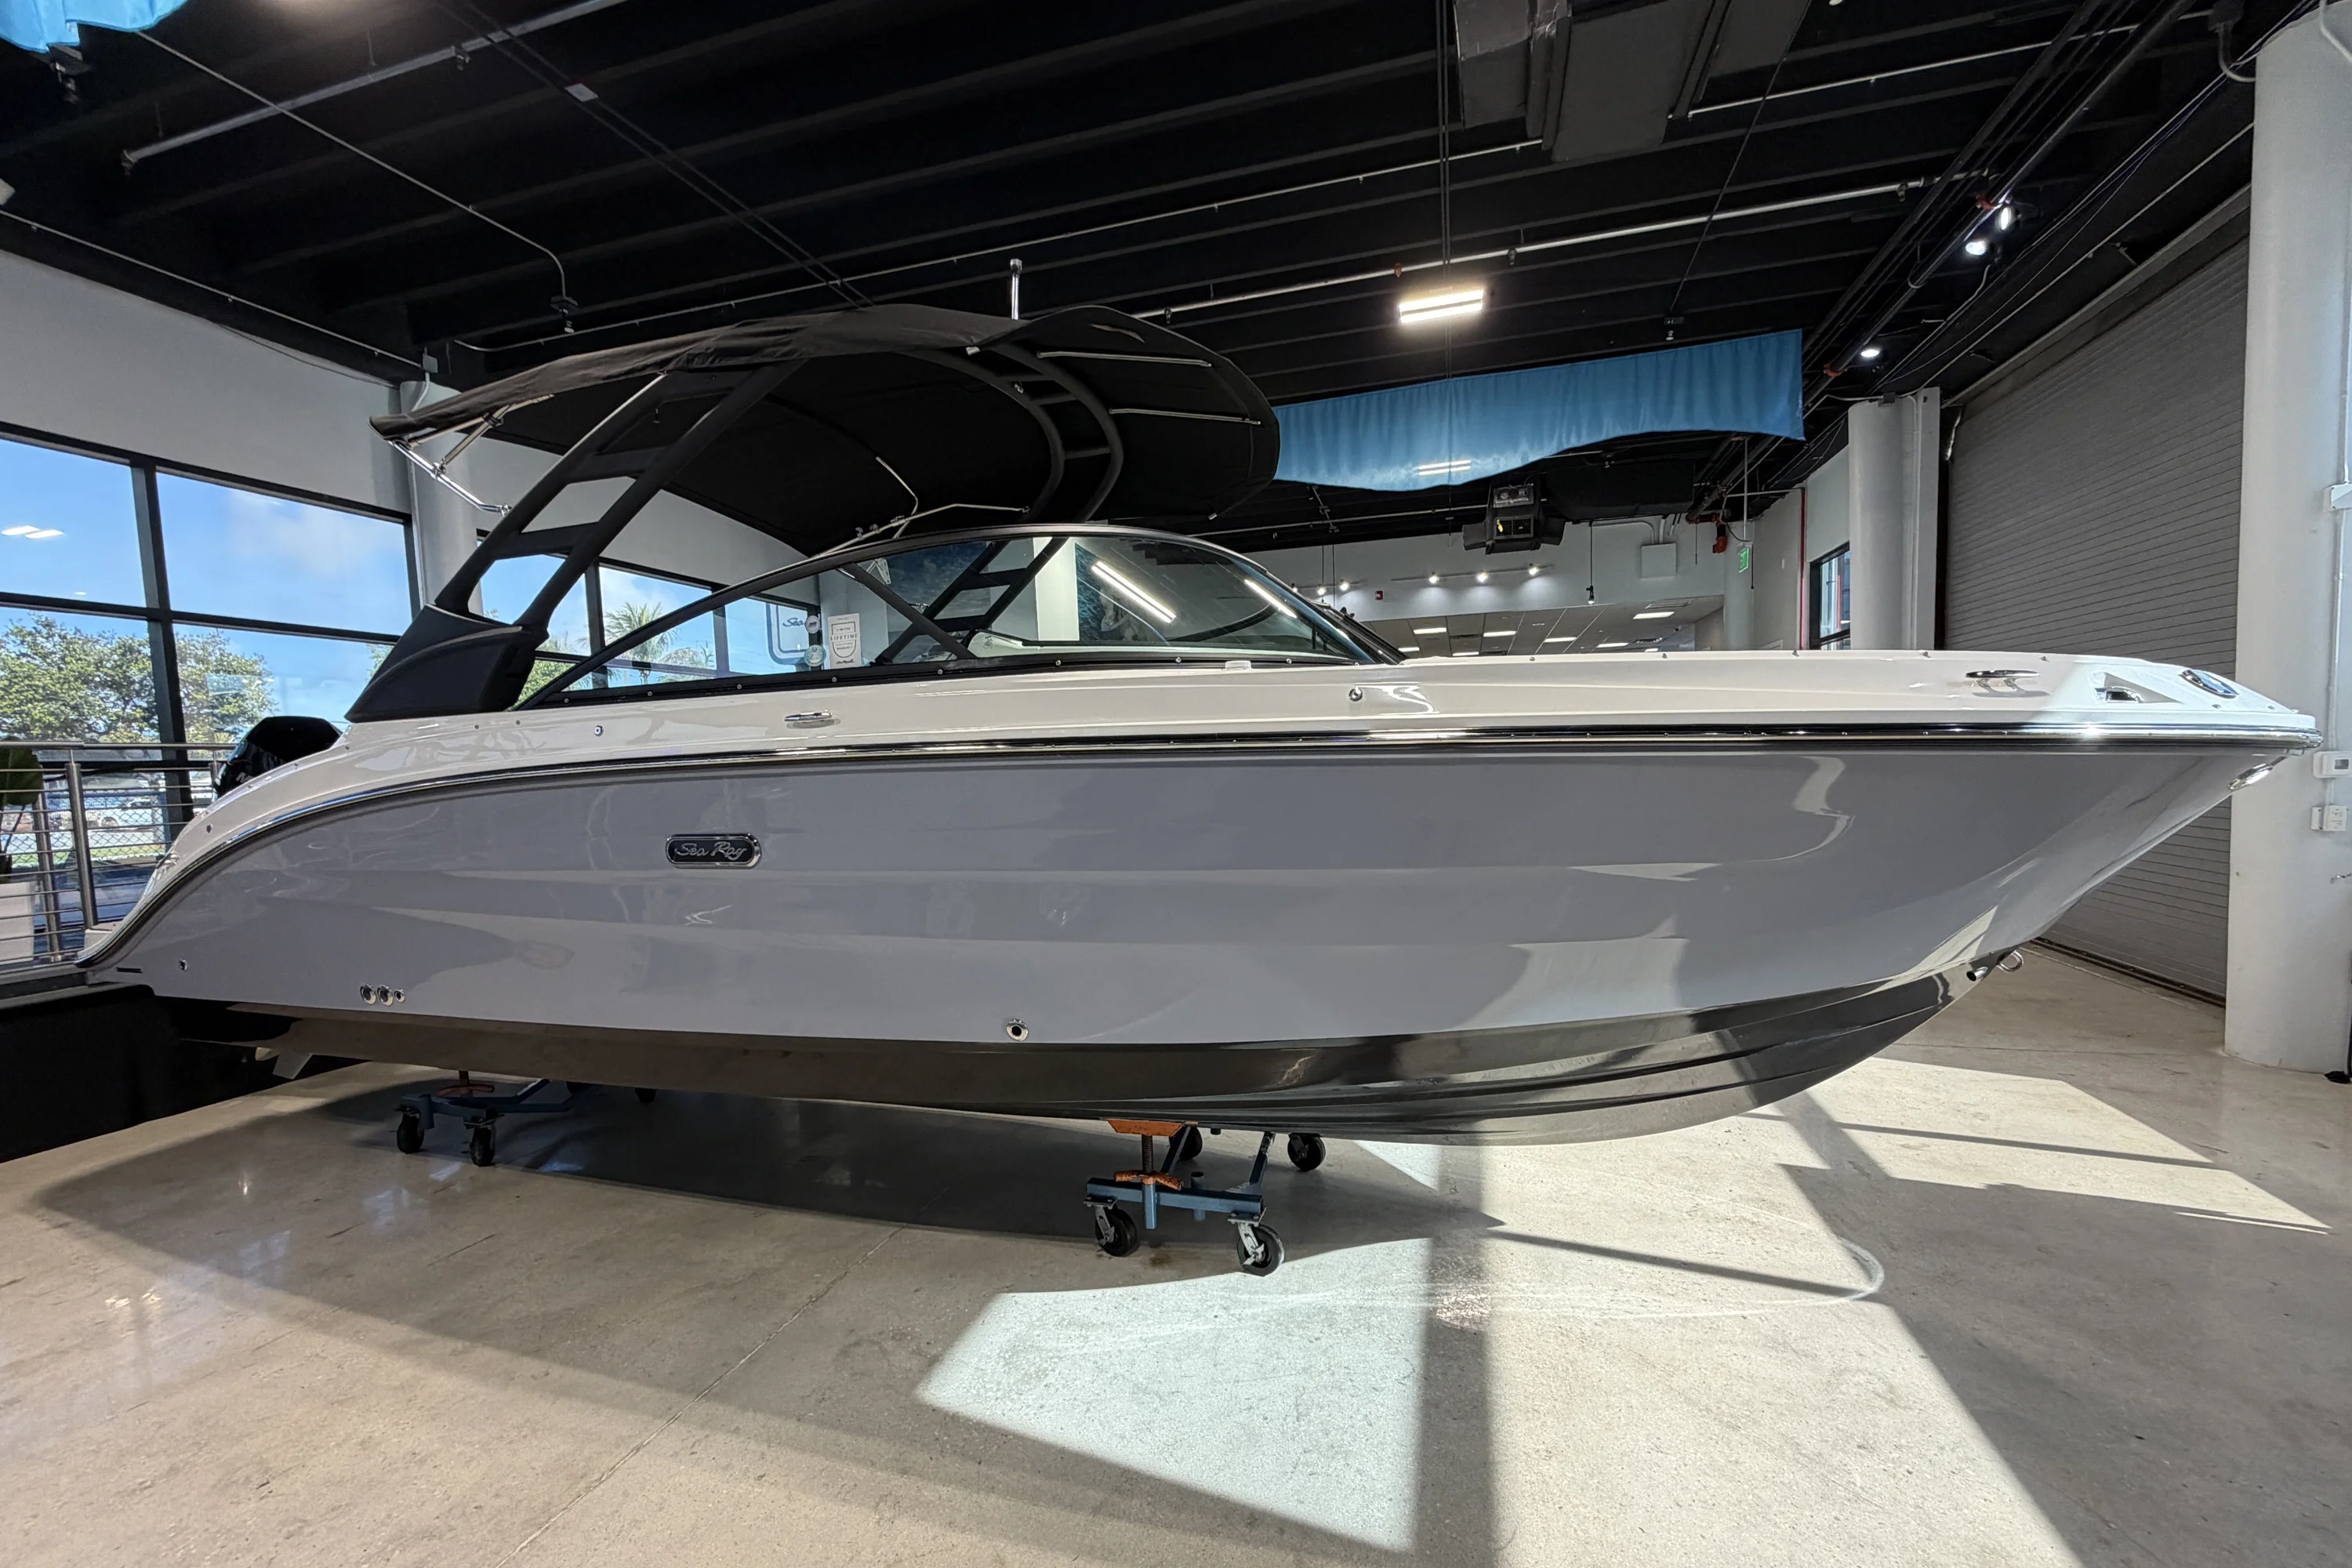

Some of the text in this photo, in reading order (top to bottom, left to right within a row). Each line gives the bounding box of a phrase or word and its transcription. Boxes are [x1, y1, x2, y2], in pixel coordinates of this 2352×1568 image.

[782, 618, 804, 627] Sea
[674, 841, 747, 861] Sea Ray
